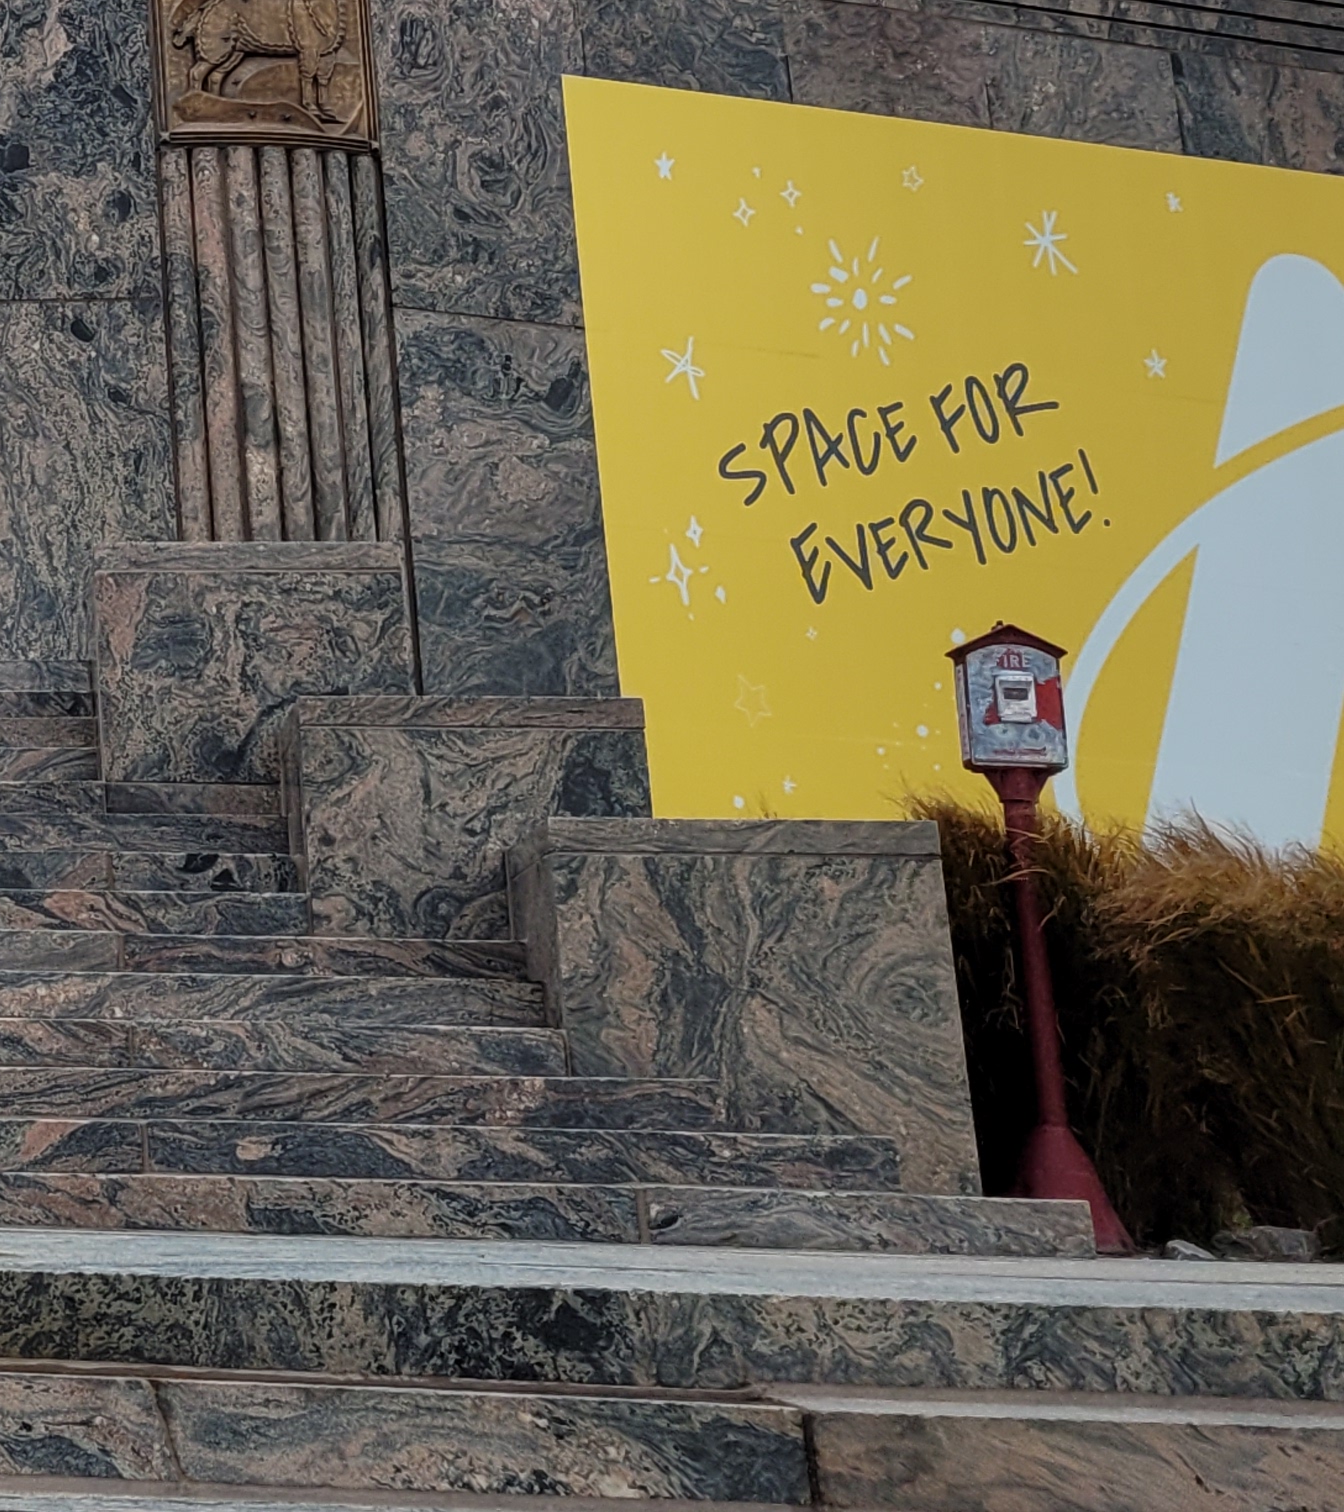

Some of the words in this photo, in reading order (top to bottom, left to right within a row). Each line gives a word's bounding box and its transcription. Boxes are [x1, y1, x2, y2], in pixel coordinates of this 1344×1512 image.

[718, 400, 917, 506] SPACE
[929, 362, 1060, 453] FOR
[789, 448, 1112, 604] EVERYONE!
